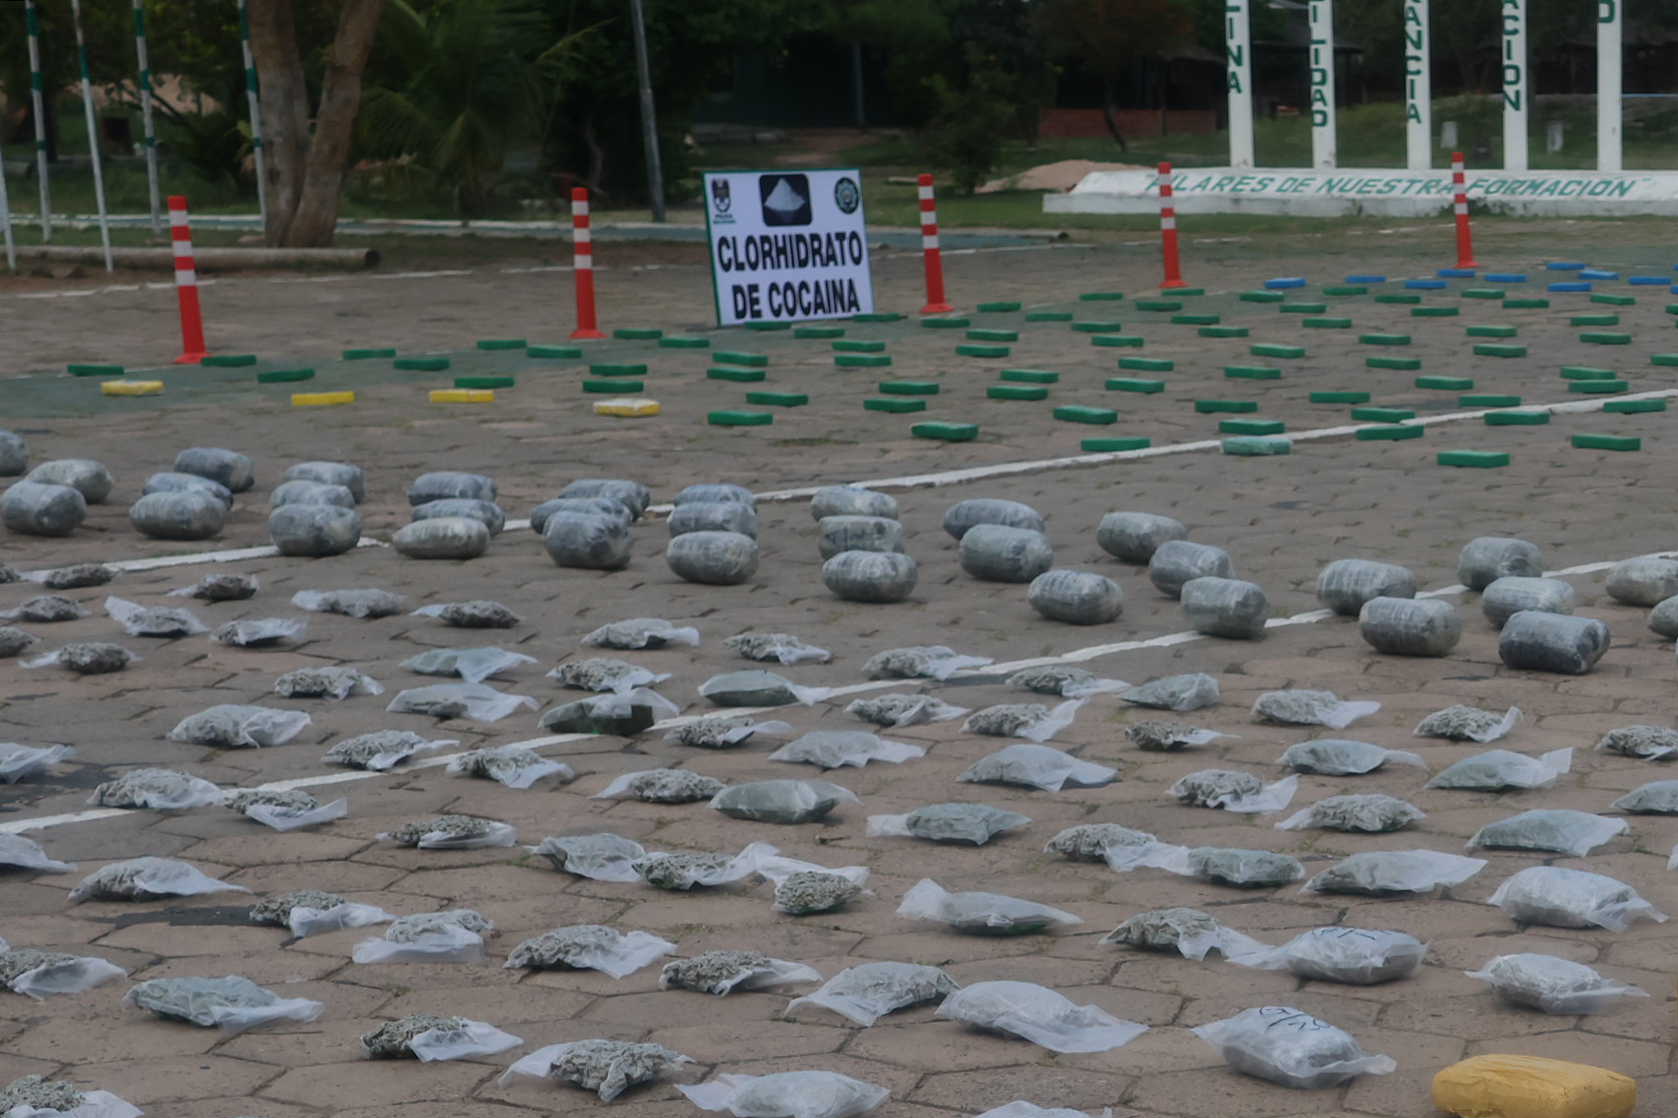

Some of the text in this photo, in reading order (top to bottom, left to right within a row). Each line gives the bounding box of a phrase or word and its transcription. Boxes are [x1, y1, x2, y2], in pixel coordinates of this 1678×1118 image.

[1275, 177, 1316, 193] DE
[1315, 177, 1455, 194] NUESTRA
[718, 231, 862, 272] CLORHIDRATO
[732, 278, 860, 319] DE COCAINA
